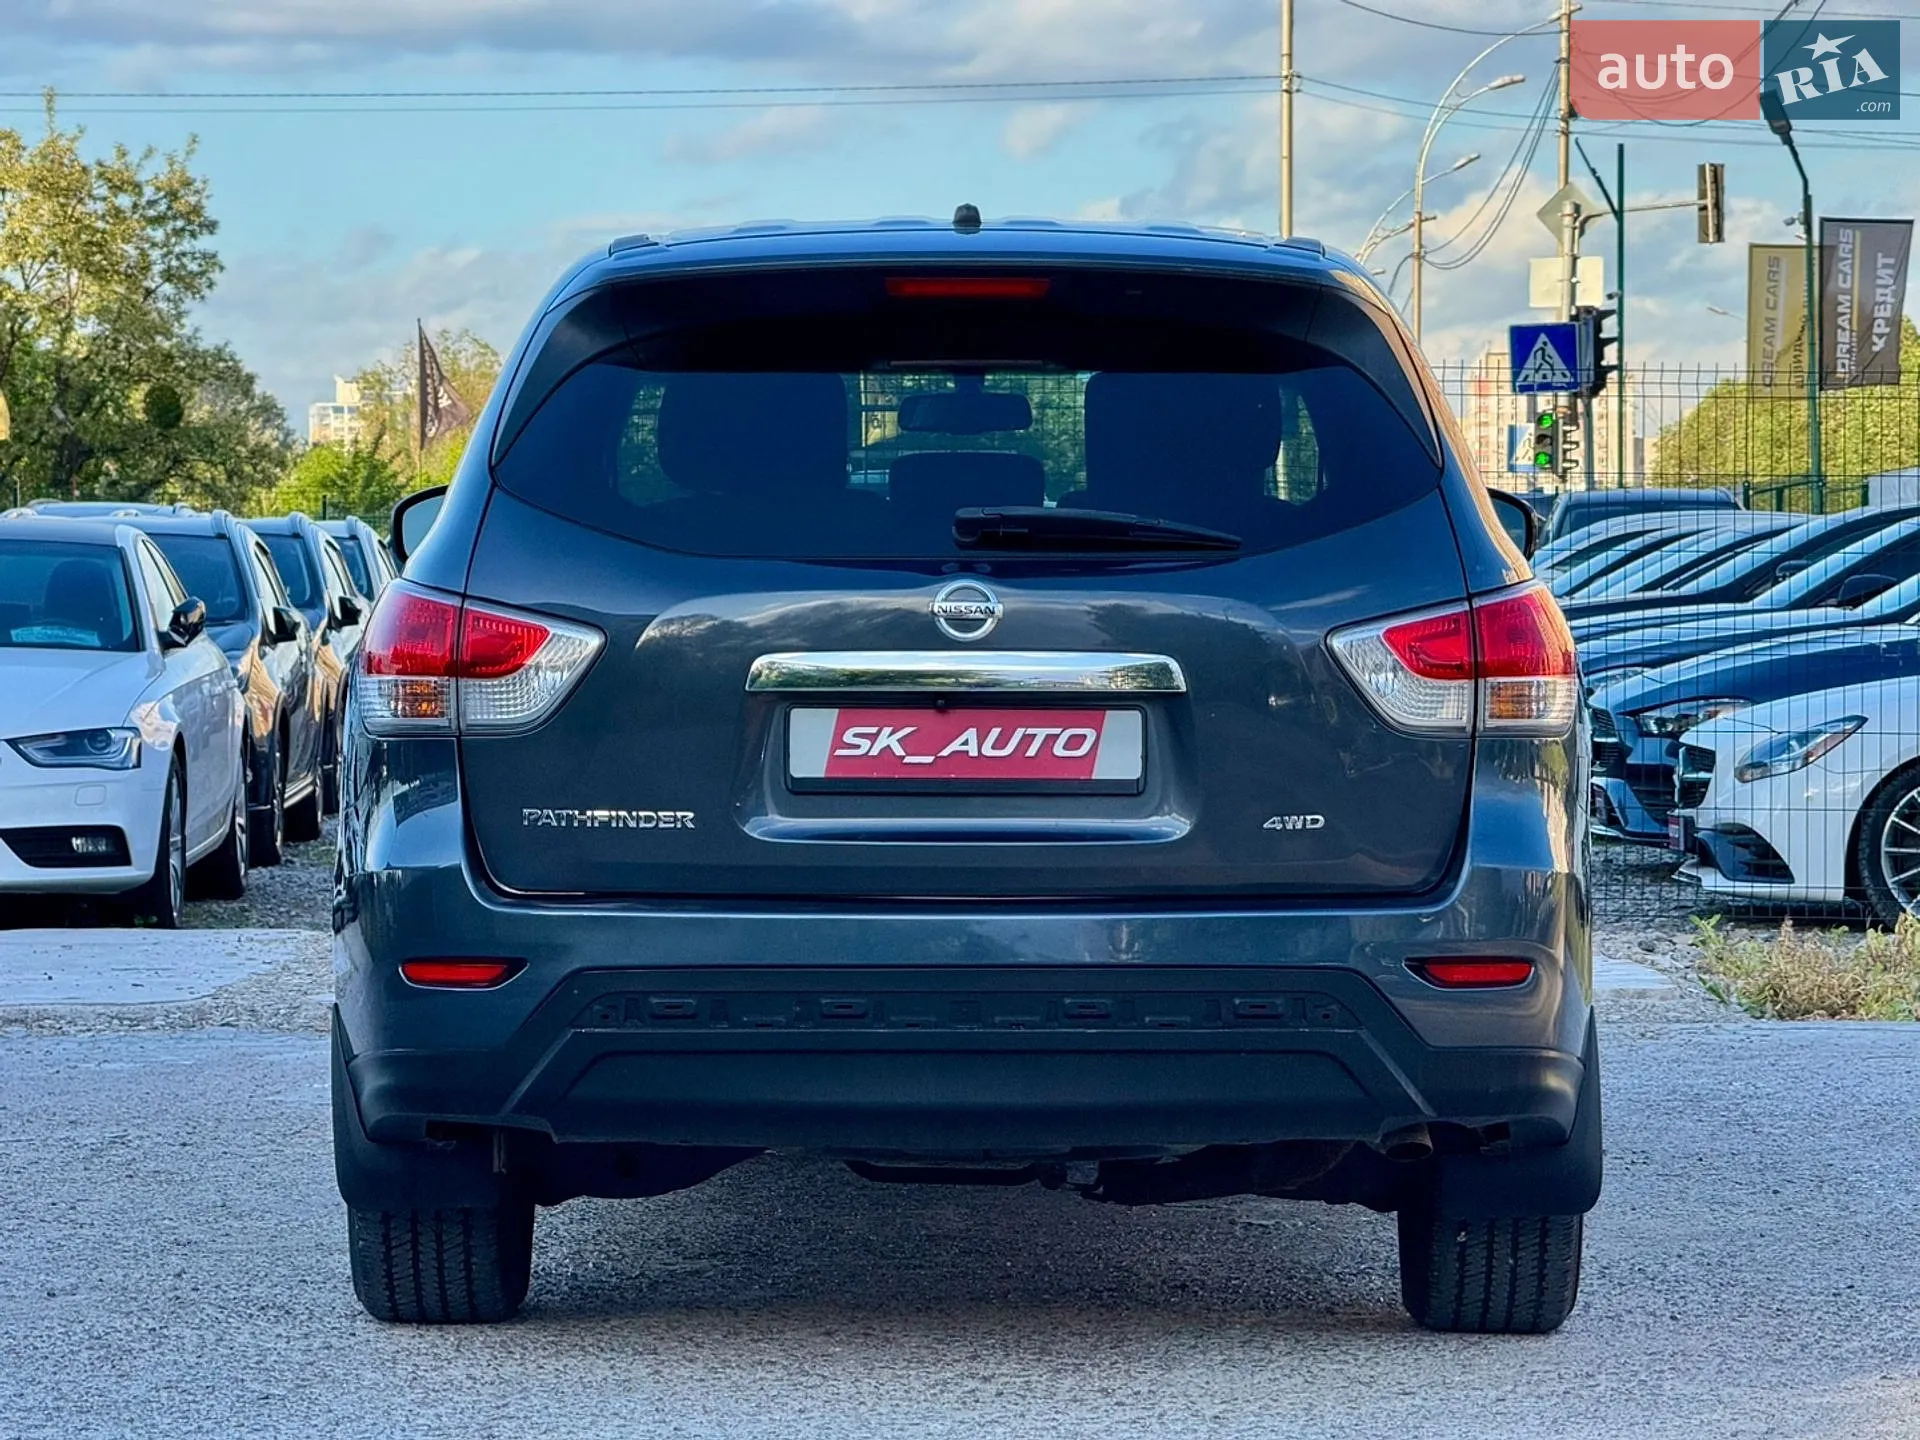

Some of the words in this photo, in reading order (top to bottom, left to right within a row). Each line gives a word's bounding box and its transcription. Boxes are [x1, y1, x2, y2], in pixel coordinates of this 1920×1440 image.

[1766, 256, 1780, 311] CARS
[1839, 228, 1853, 289] CARS
[1872, 252, 1896, 352] КРЕДИТ
[1762, 317, 1778, 387] DREAM
[1835, 295, 1852, 377] DREAM
[936, 604, 996, 616] NISSAN
[833, 726, 1098, 764] SK_AUTO
[521, 808, 696, 829] PATHFINDER
[1262, 814, 1326, 830] 4WD
